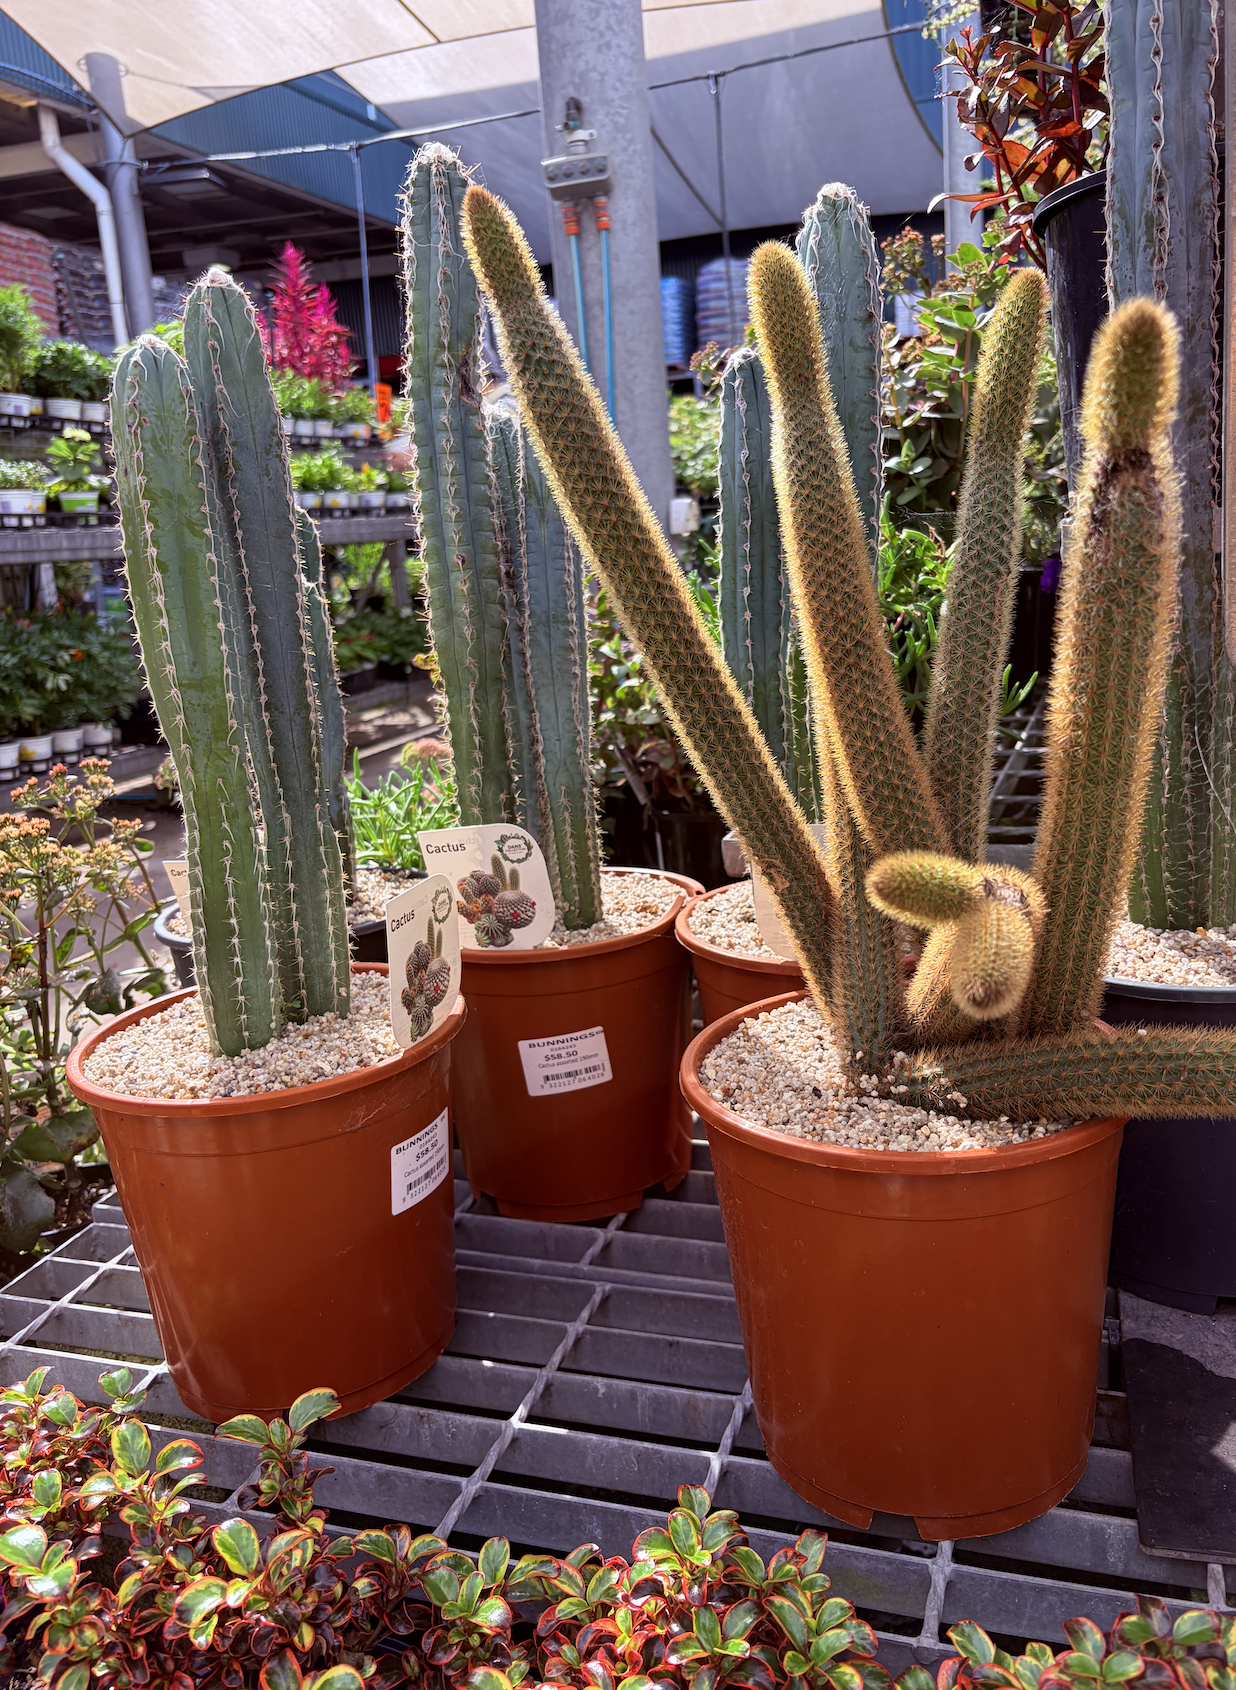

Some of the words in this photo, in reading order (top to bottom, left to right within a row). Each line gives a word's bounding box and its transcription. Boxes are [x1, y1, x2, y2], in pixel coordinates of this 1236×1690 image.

[425, 842, 467, 855] Cactus
[391, 909, 416, 933] Cactus
[528, 1032, 595, 1048] BUNNINGS
[550, 1043, 577, 1053] 0164243
[538, 1061, 556, 1069] Cactus
[556, 1057, 579, 1066] assorted
[579, 1052, 600, 1062] 190mm
[544, 1050, 579, 1062] $58.50
[578, 1072, 605, 1083] 064026
[395, 1122, 439, 1155] BUNNINGS
[416, 1139, 439, 1162] $58.50
[404, 1166, 420, 1178] Cactus
